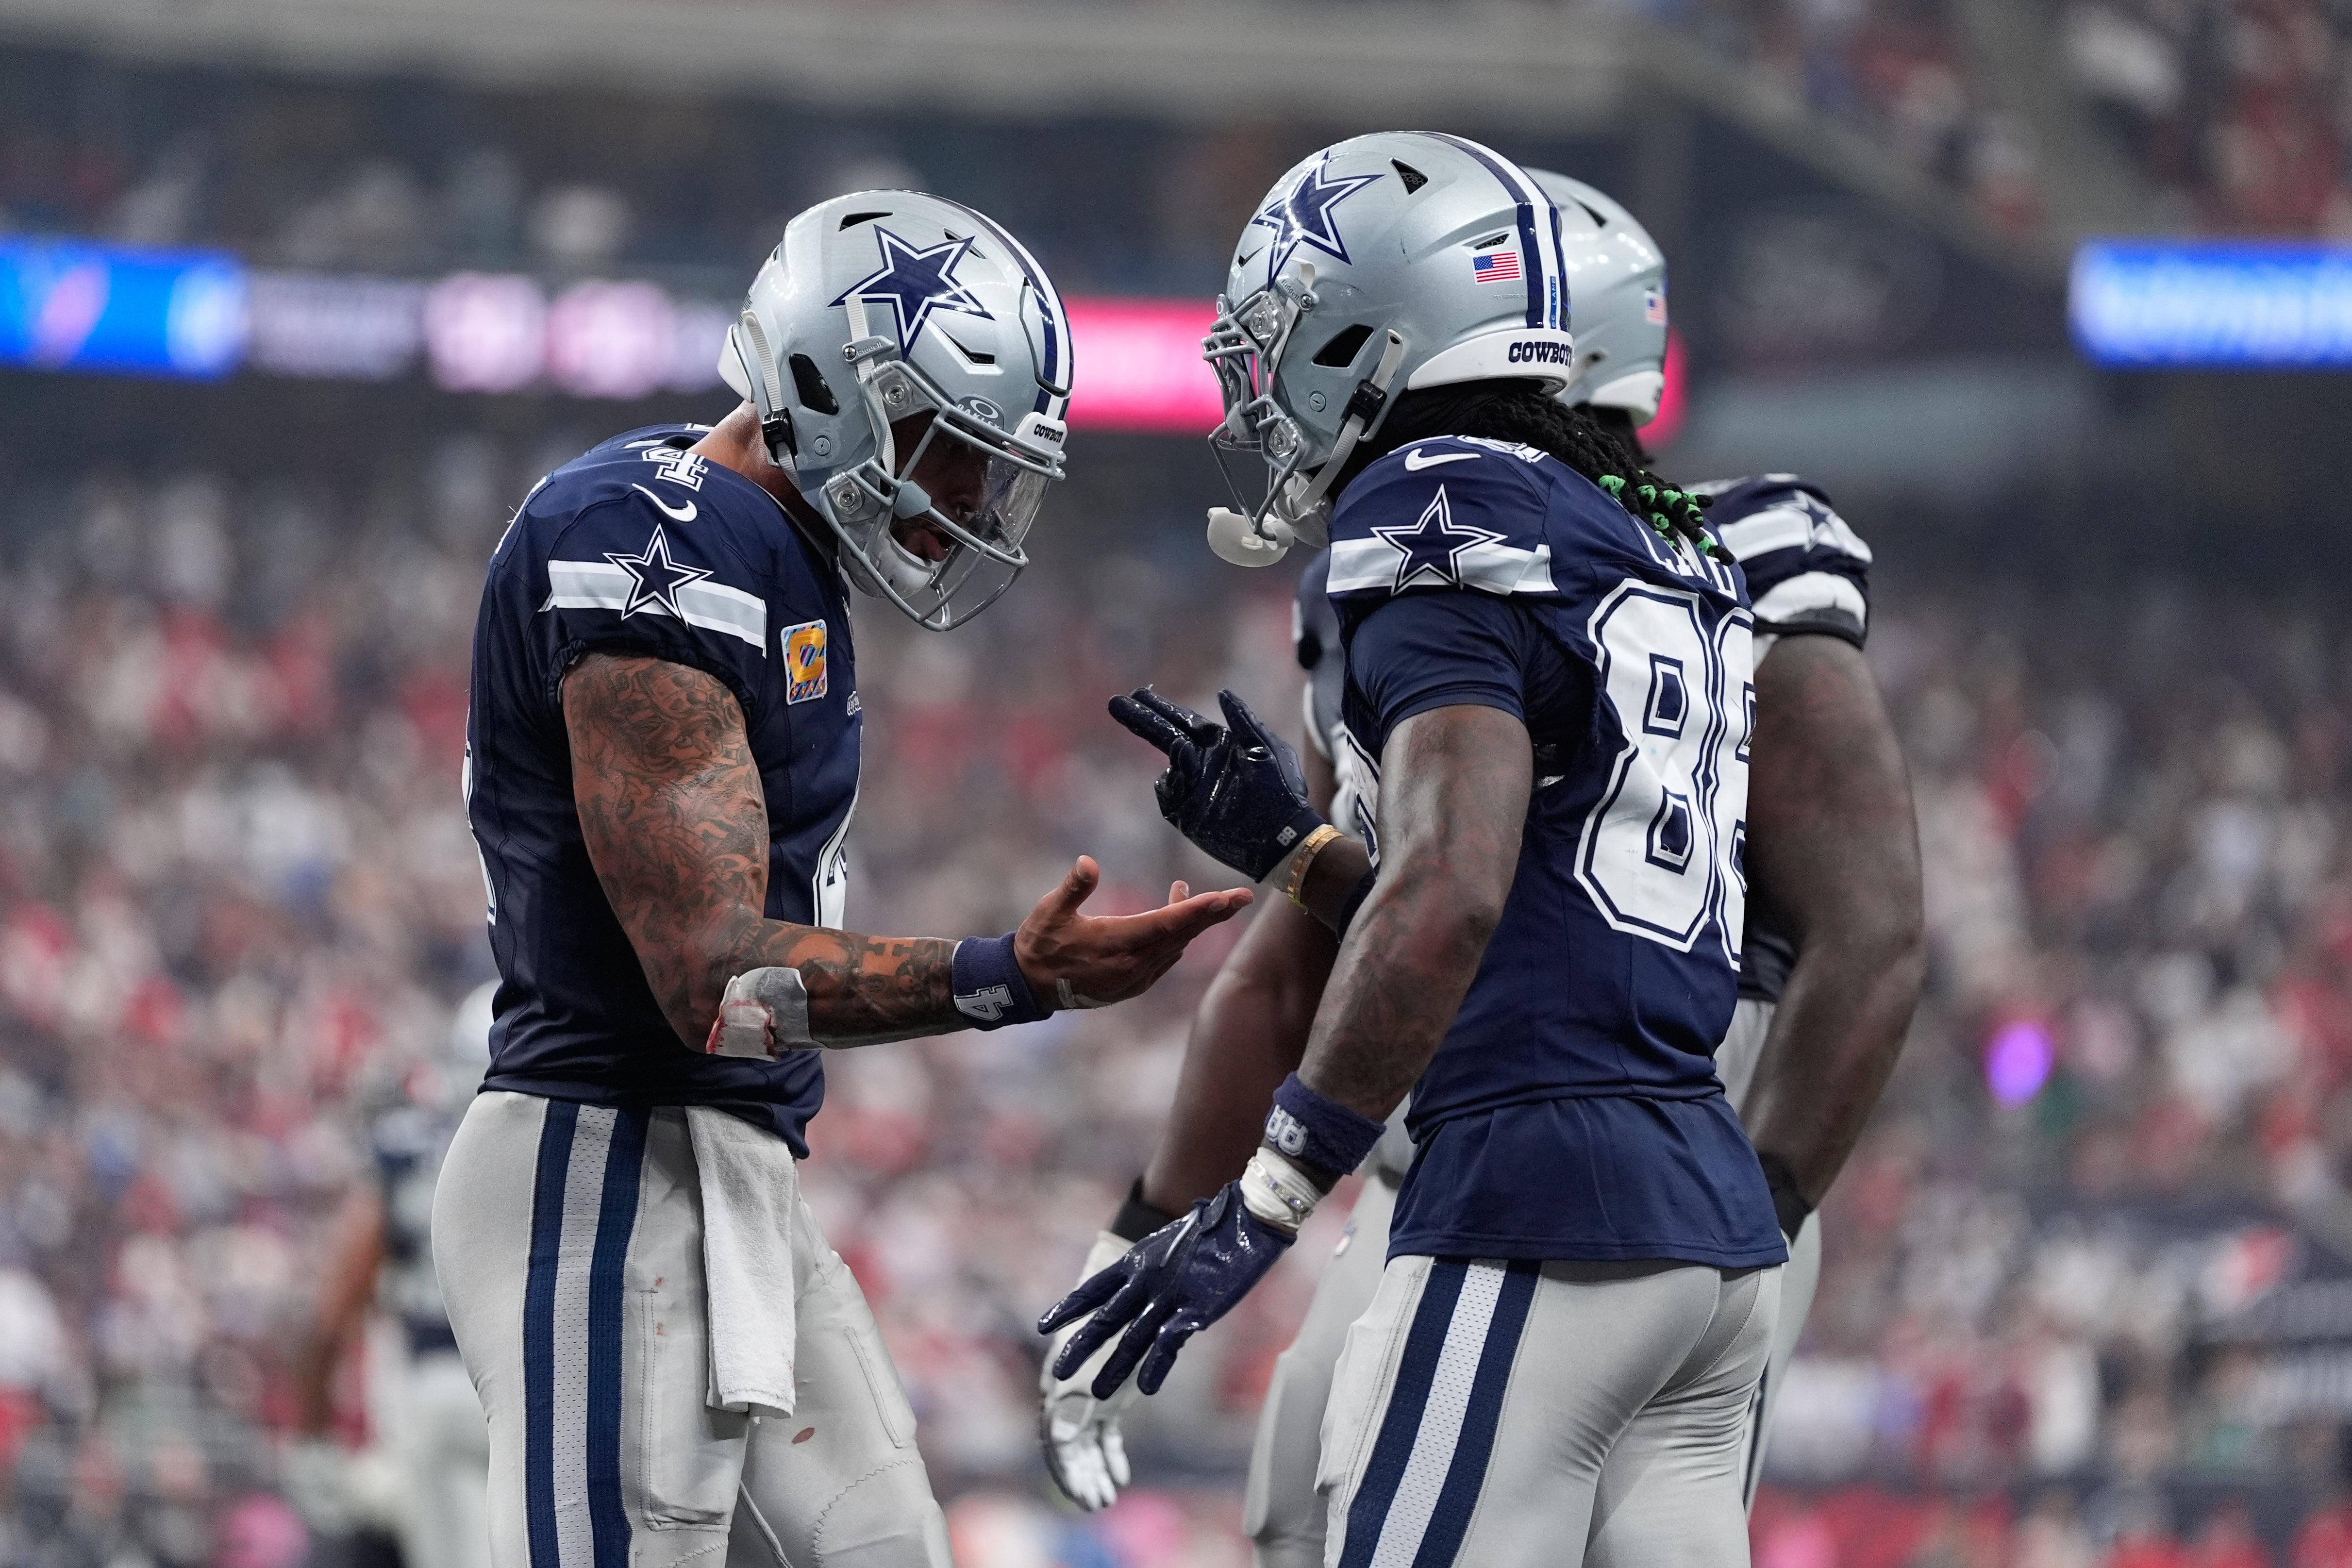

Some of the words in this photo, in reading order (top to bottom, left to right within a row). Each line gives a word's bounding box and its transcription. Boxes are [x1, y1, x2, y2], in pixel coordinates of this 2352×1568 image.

[642, 447, 709, 492] 4
[789, 628, 825, 684] C
[1277, 826, 1298, 847] 88
[953, 984, 1014, 1021] 4
[1266, 1104, 1308, 1156] 88
